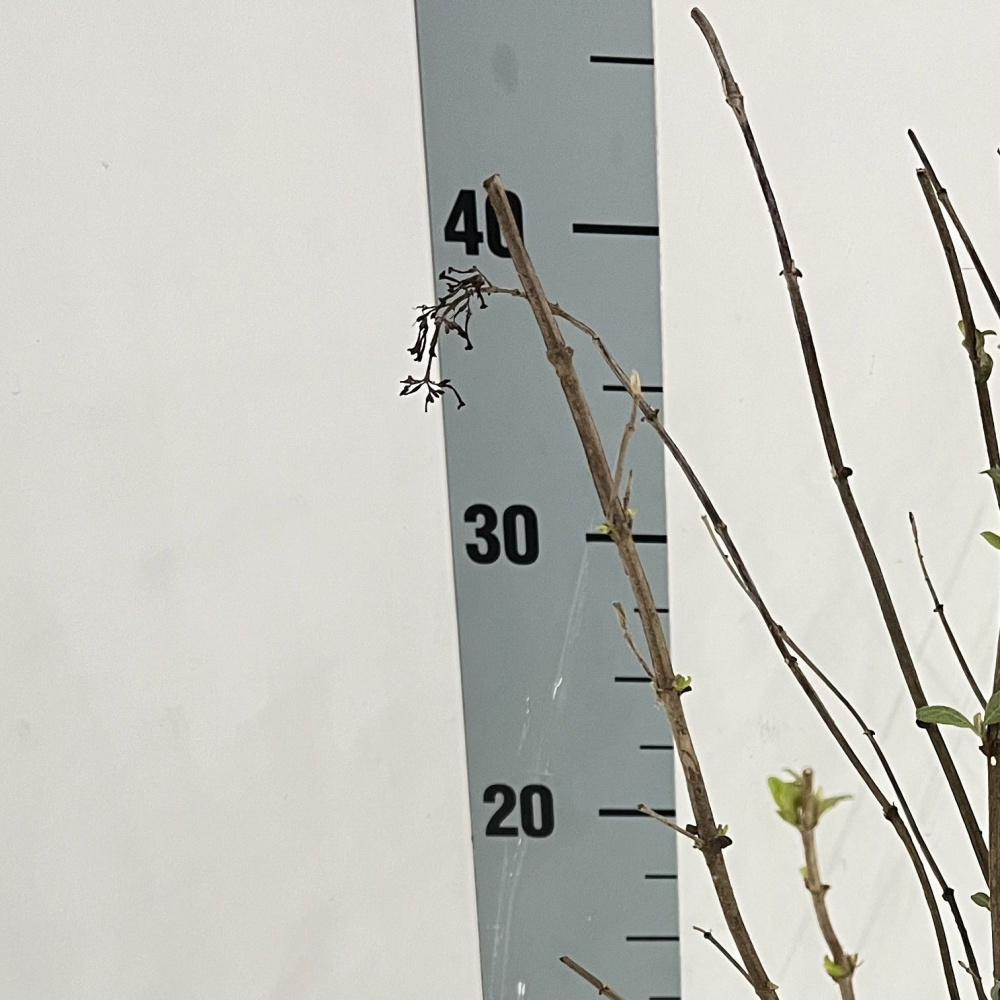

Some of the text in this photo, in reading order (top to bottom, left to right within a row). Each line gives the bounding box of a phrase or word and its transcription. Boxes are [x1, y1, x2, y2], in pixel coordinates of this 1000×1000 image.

[444, 189, 524, 258] 40
[463, 504, 539, 566] 30
[482, 783, 555, 838] 20
